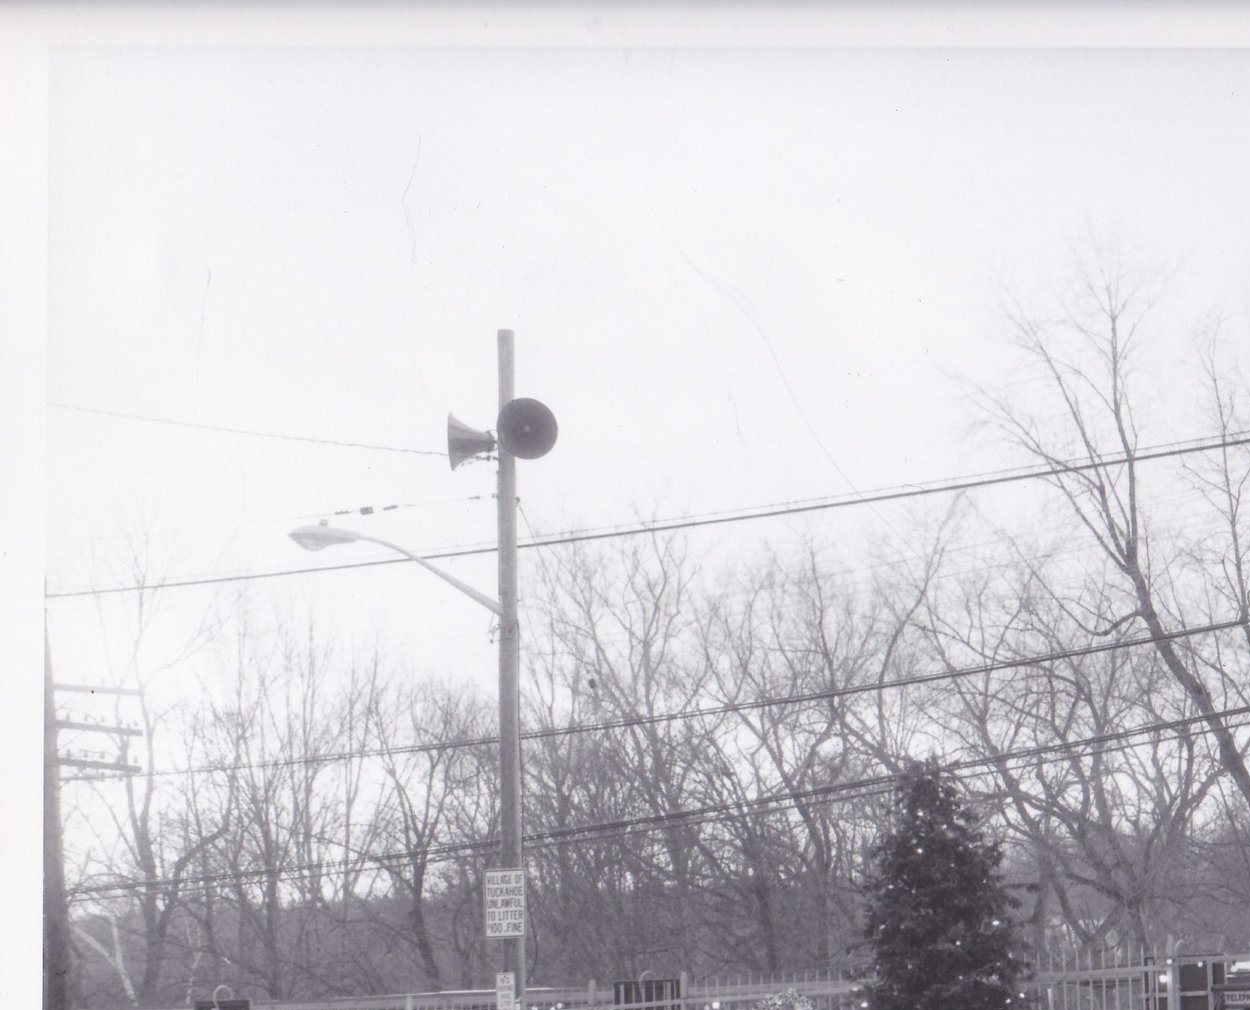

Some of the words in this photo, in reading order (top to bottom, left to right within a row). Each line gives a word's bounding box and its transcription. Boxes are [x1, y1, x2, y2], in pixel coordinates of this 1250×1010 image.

[487, 875, 512, 885] VILLAGE
[515, 874, 523, 884] OF
[487, 886, 523, 897] TUCKAHOE
[487, 898, 523, 909] UNLAWFUL
[487, 911, 495, 921] TO
[498, 910, 523, 921] LITTER
[507, 922, 522, 933] FINE
